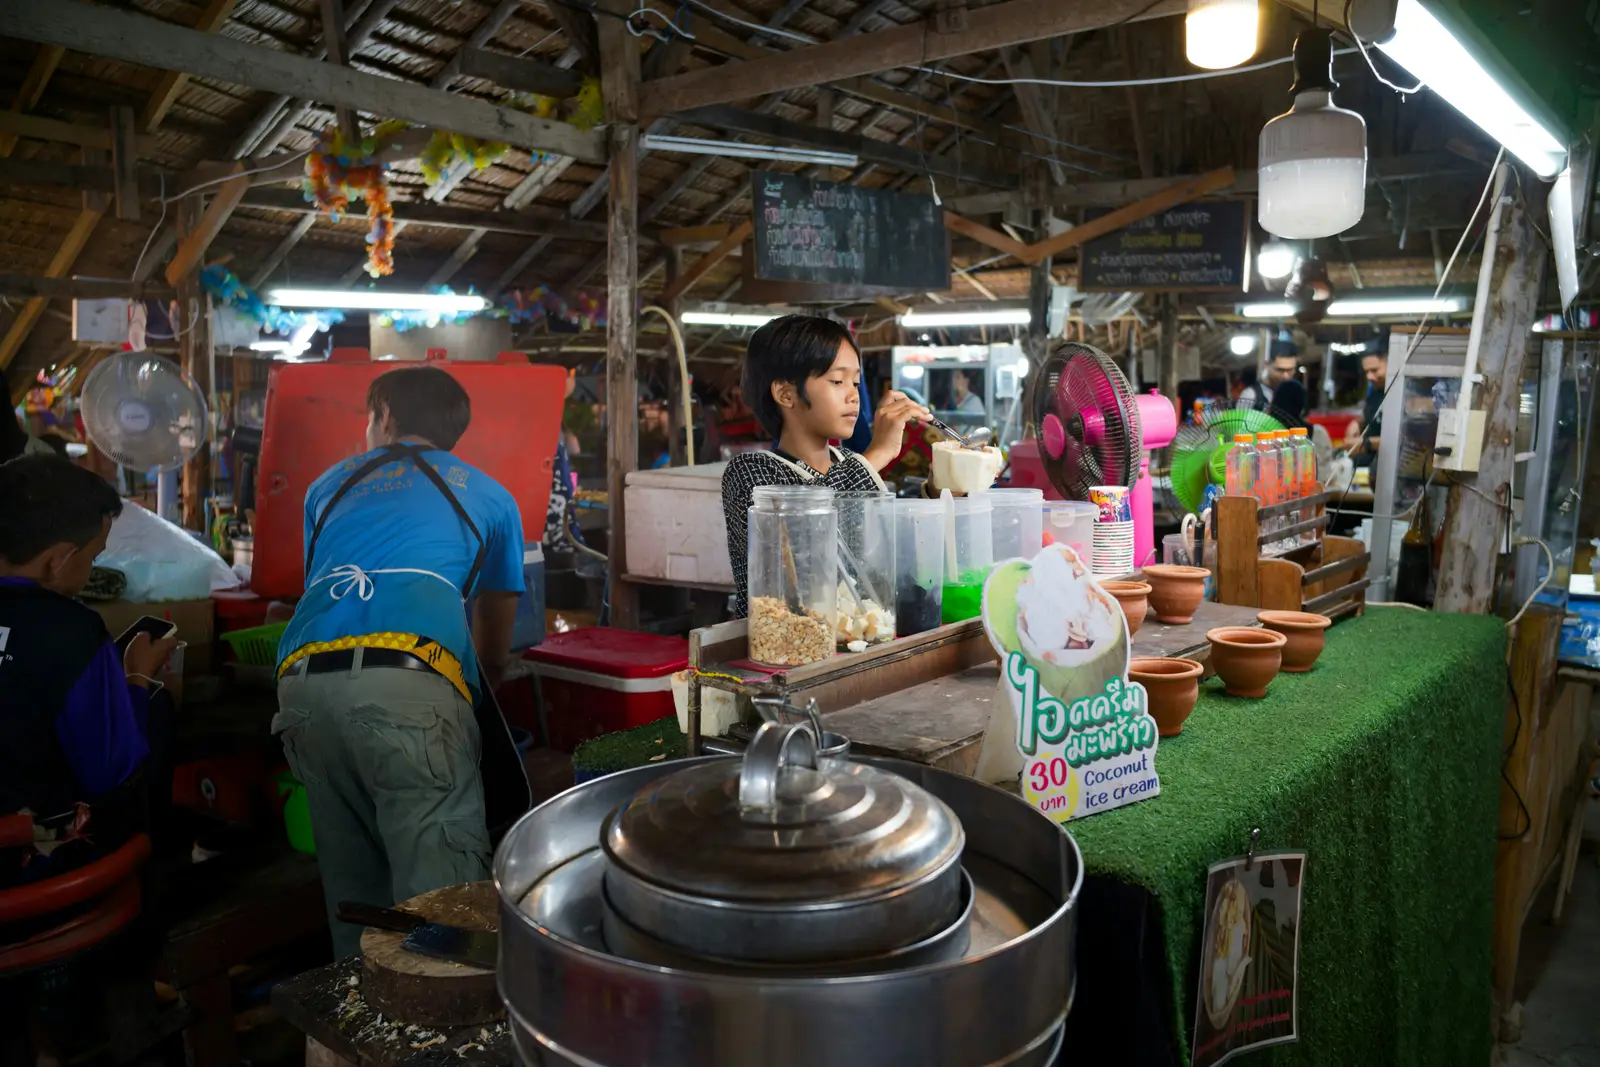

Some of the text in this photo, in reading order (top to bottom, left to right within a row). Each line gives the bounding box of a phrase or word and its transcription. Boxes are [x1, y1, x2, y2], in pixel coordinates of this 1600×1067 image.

[1008, 651, 1141, 752] ไอศครีม
[1065, 714, 1153, 764] มะพร้าว
[1030, 757, 1067, 791] 30
[1084, 754, 1148, 786] Coconut
[1040, 795, 1067, 811] บาท
[1085, 777, 1158, 809] ice cream
